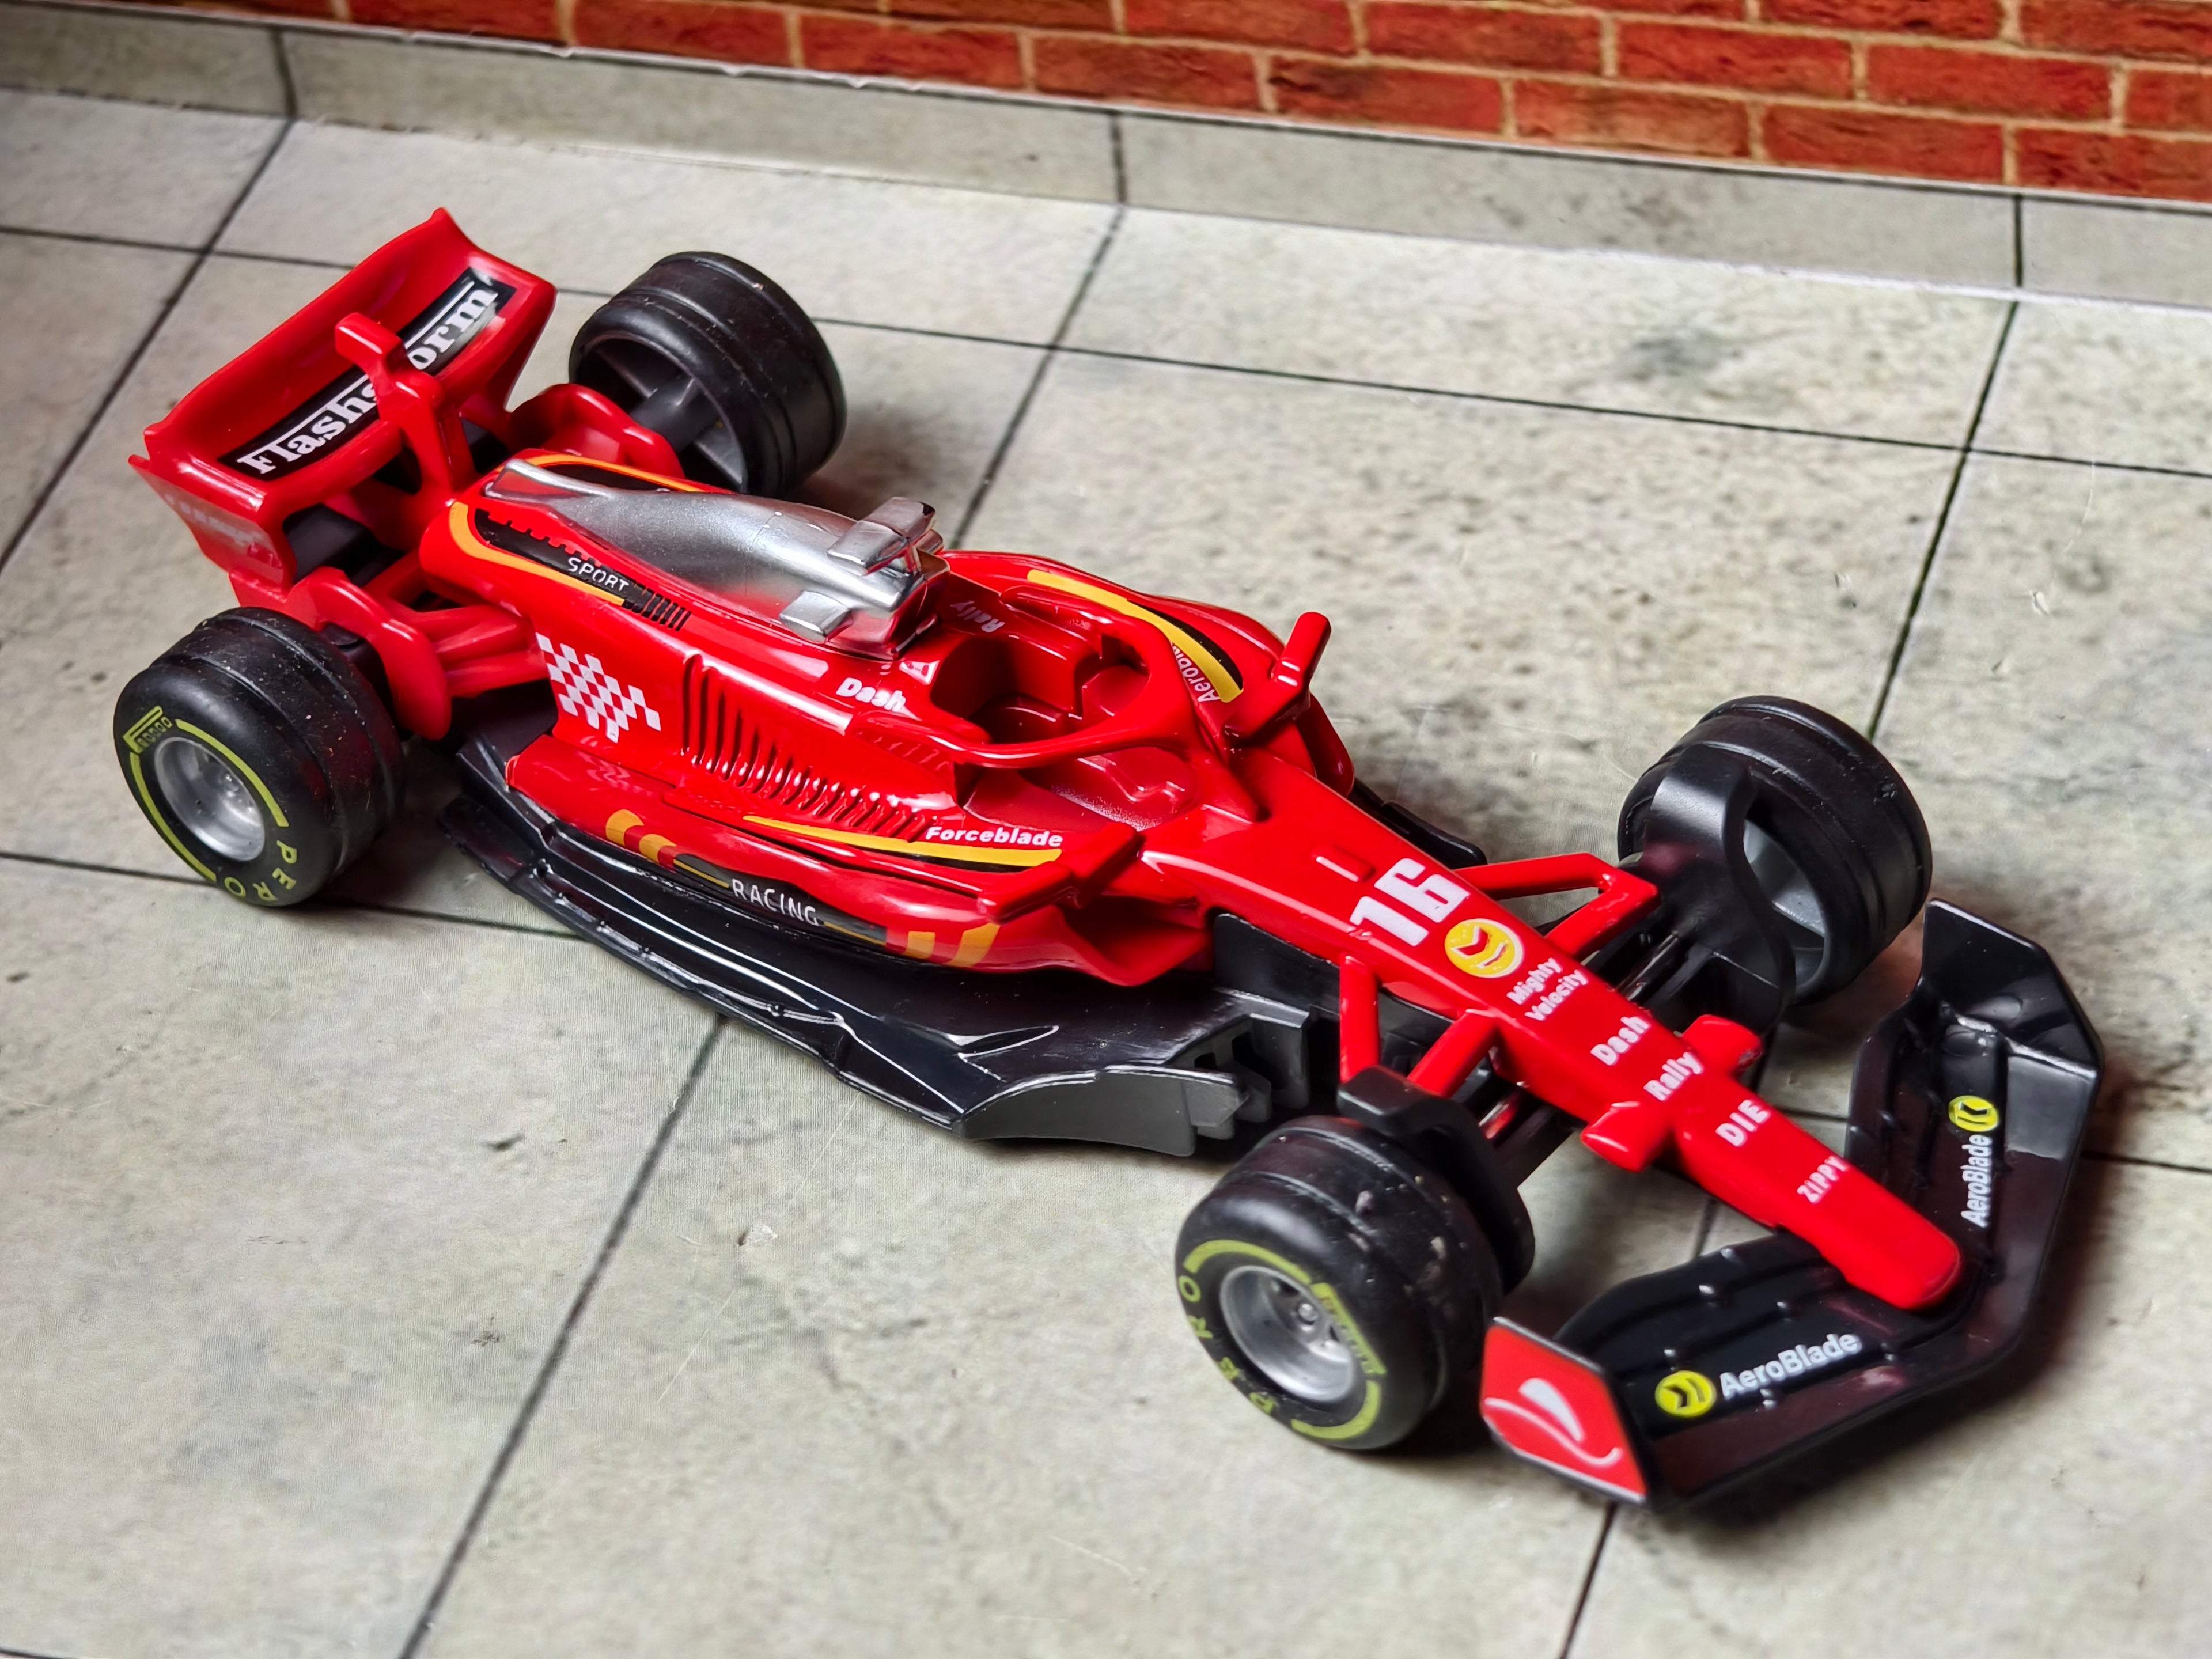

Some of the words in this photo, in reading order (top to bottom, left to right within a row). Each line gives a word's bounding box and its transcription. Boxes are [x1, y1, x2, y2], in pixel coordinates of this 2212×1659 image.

[237, 283, 499, 475] Flashorm
[567, 556, 630, 592] SPORT
[949, 600, 1005, 632] Rally
[835, 677, 906, 712] Dash
[925, 826, 1063, 848] Forceblade
[224, 839, 297, 902] PERO
[732, 877, 820, 926] RACING
[1349, 858, 1471, 946] 16
[1506, 957, 1563, 1005] Mighty
[1524, 969, 1589, 1021] Velocity
[1590, 1016, 1652, 1066] Dash
[1643, 1051, 1705, 1101] Rally
[1715, 1099, 1771, 1147] DIE
[1960, 1134, 1993, 1228] AeroBlade
[1718, 1332, 1863, 1400] AeroBlade
